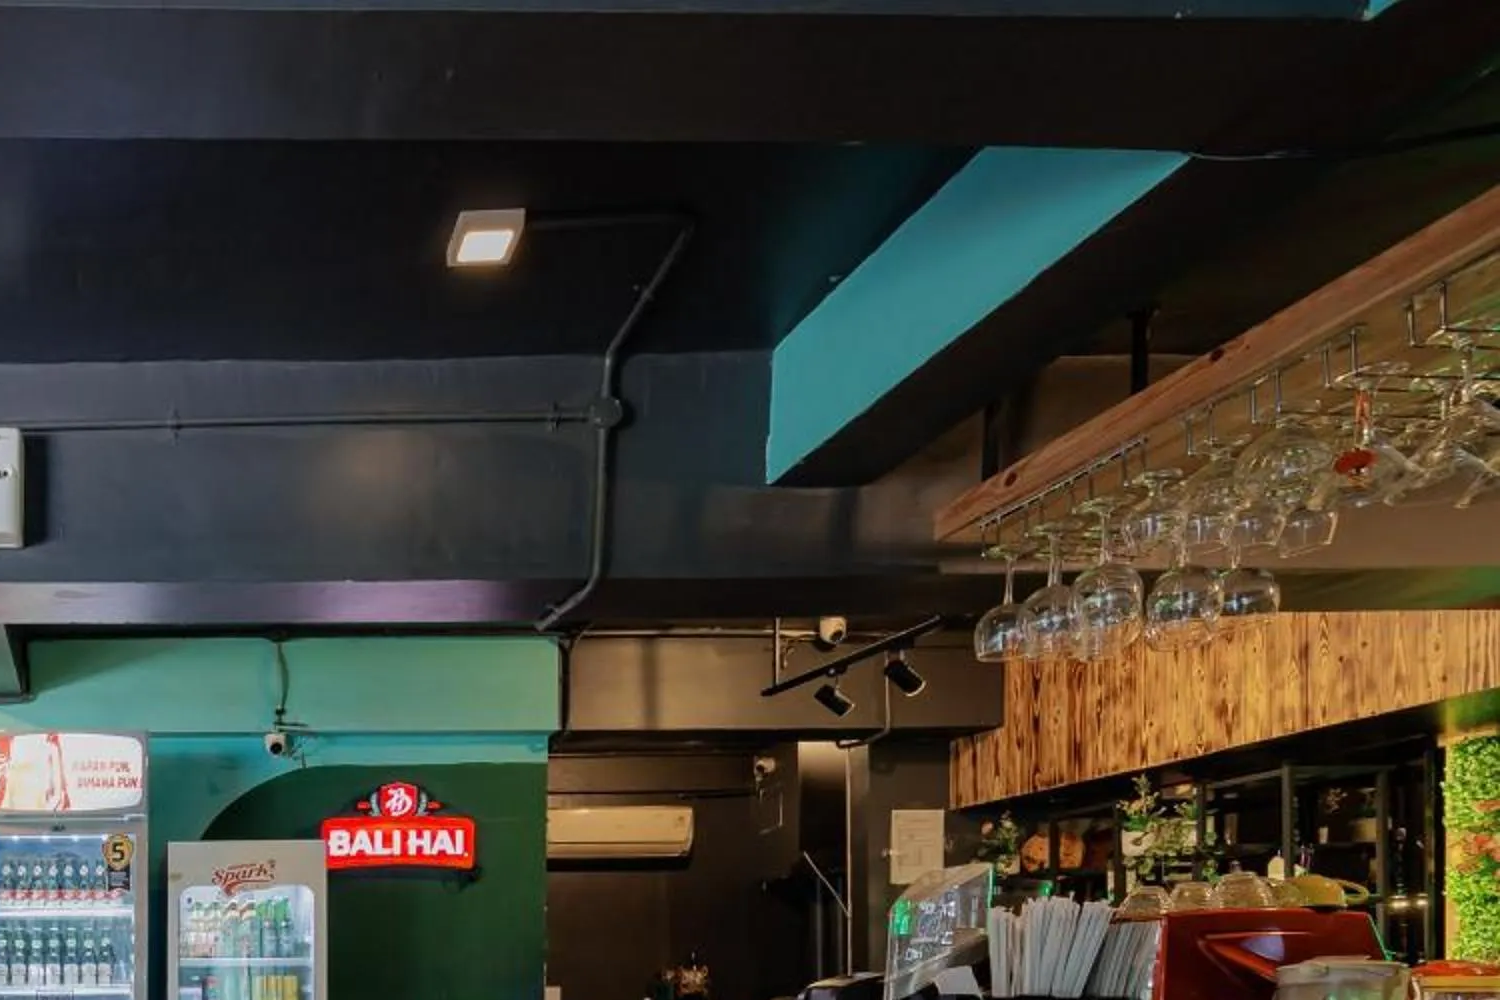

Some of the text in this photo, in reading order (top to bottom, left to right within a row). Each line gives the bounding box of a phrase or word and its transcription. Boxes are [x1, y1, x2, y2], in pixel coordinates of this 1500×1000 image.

[112, 842, 125, 862] 5
[328, 829, 467, 856] BALI HAI
